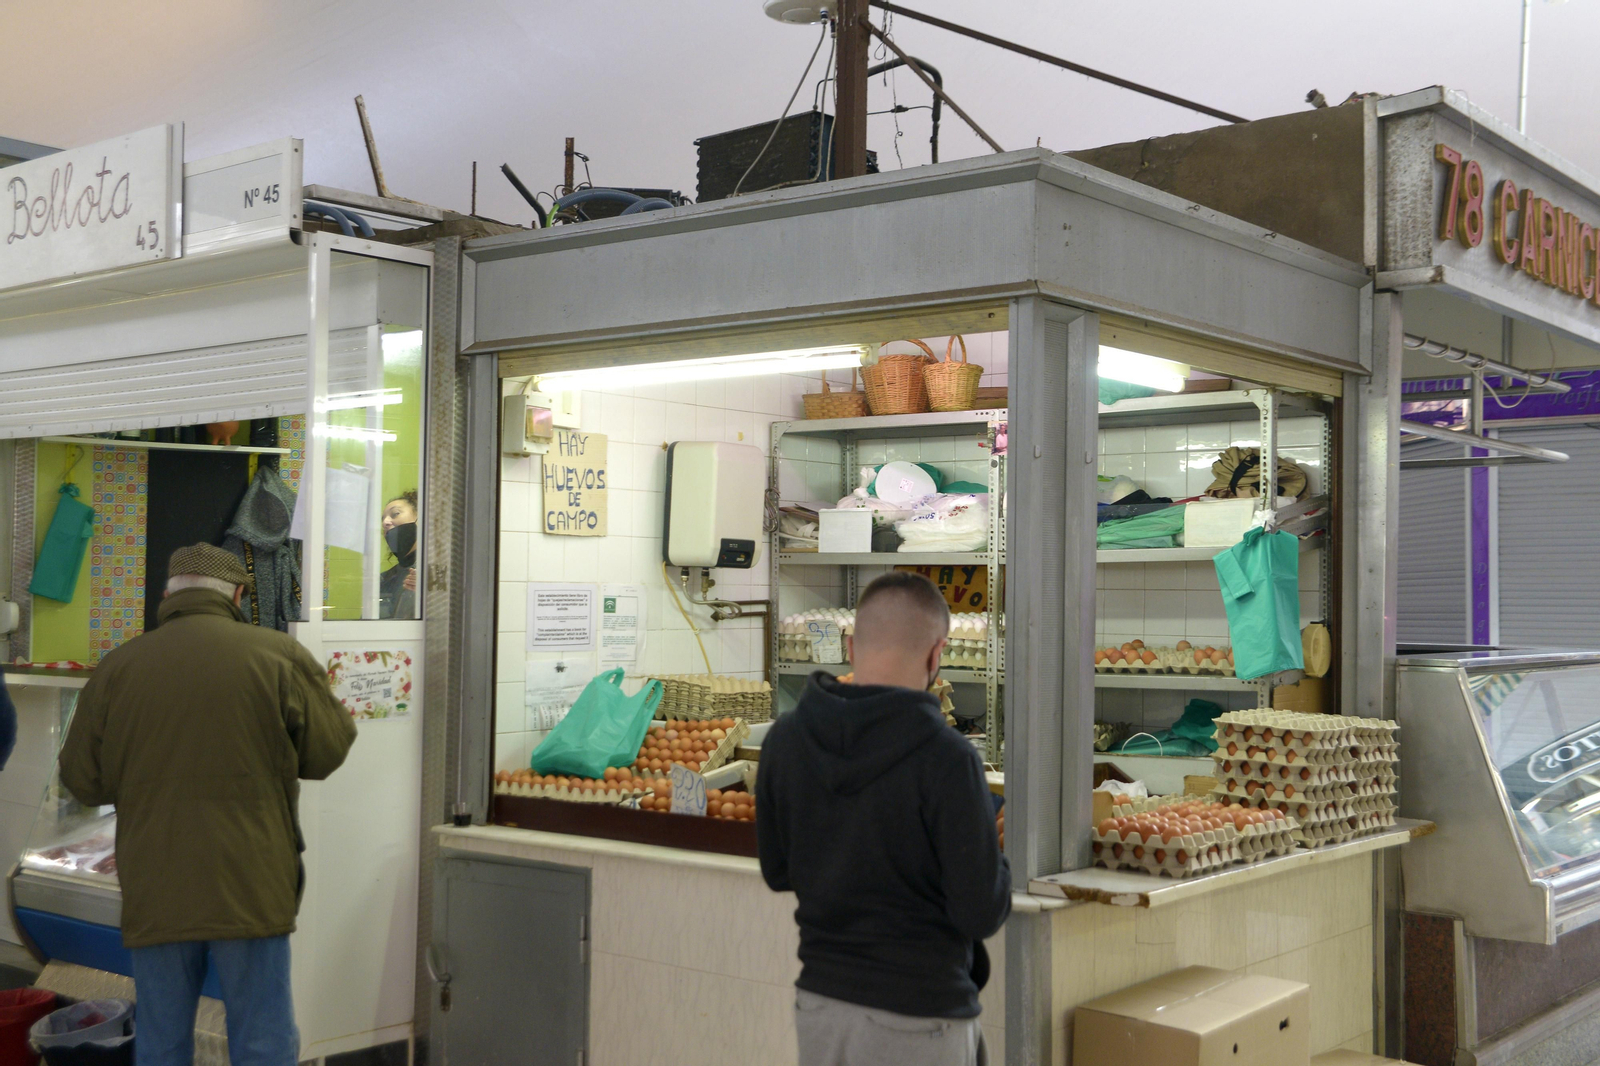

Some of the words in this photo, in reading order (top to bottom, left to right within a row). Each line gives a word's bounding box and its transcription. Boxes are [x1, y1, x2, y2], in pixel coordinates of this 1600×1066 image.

[7, 155, 133, 245] Bellota
[263, 183, 280, 204] 45
[1434, 143, 1484, 249] 78
[135, 220, 159, 251] 45
[558, 431, 588, 457] HAY
[544, 463, 606, 493] HUEVOS
[568, 491, 581, 507] DE
[547, 509, 598, 531] CAMPO
[916, 566, 977, 585] HAY
[365, 675, 391, 689] Navidad
